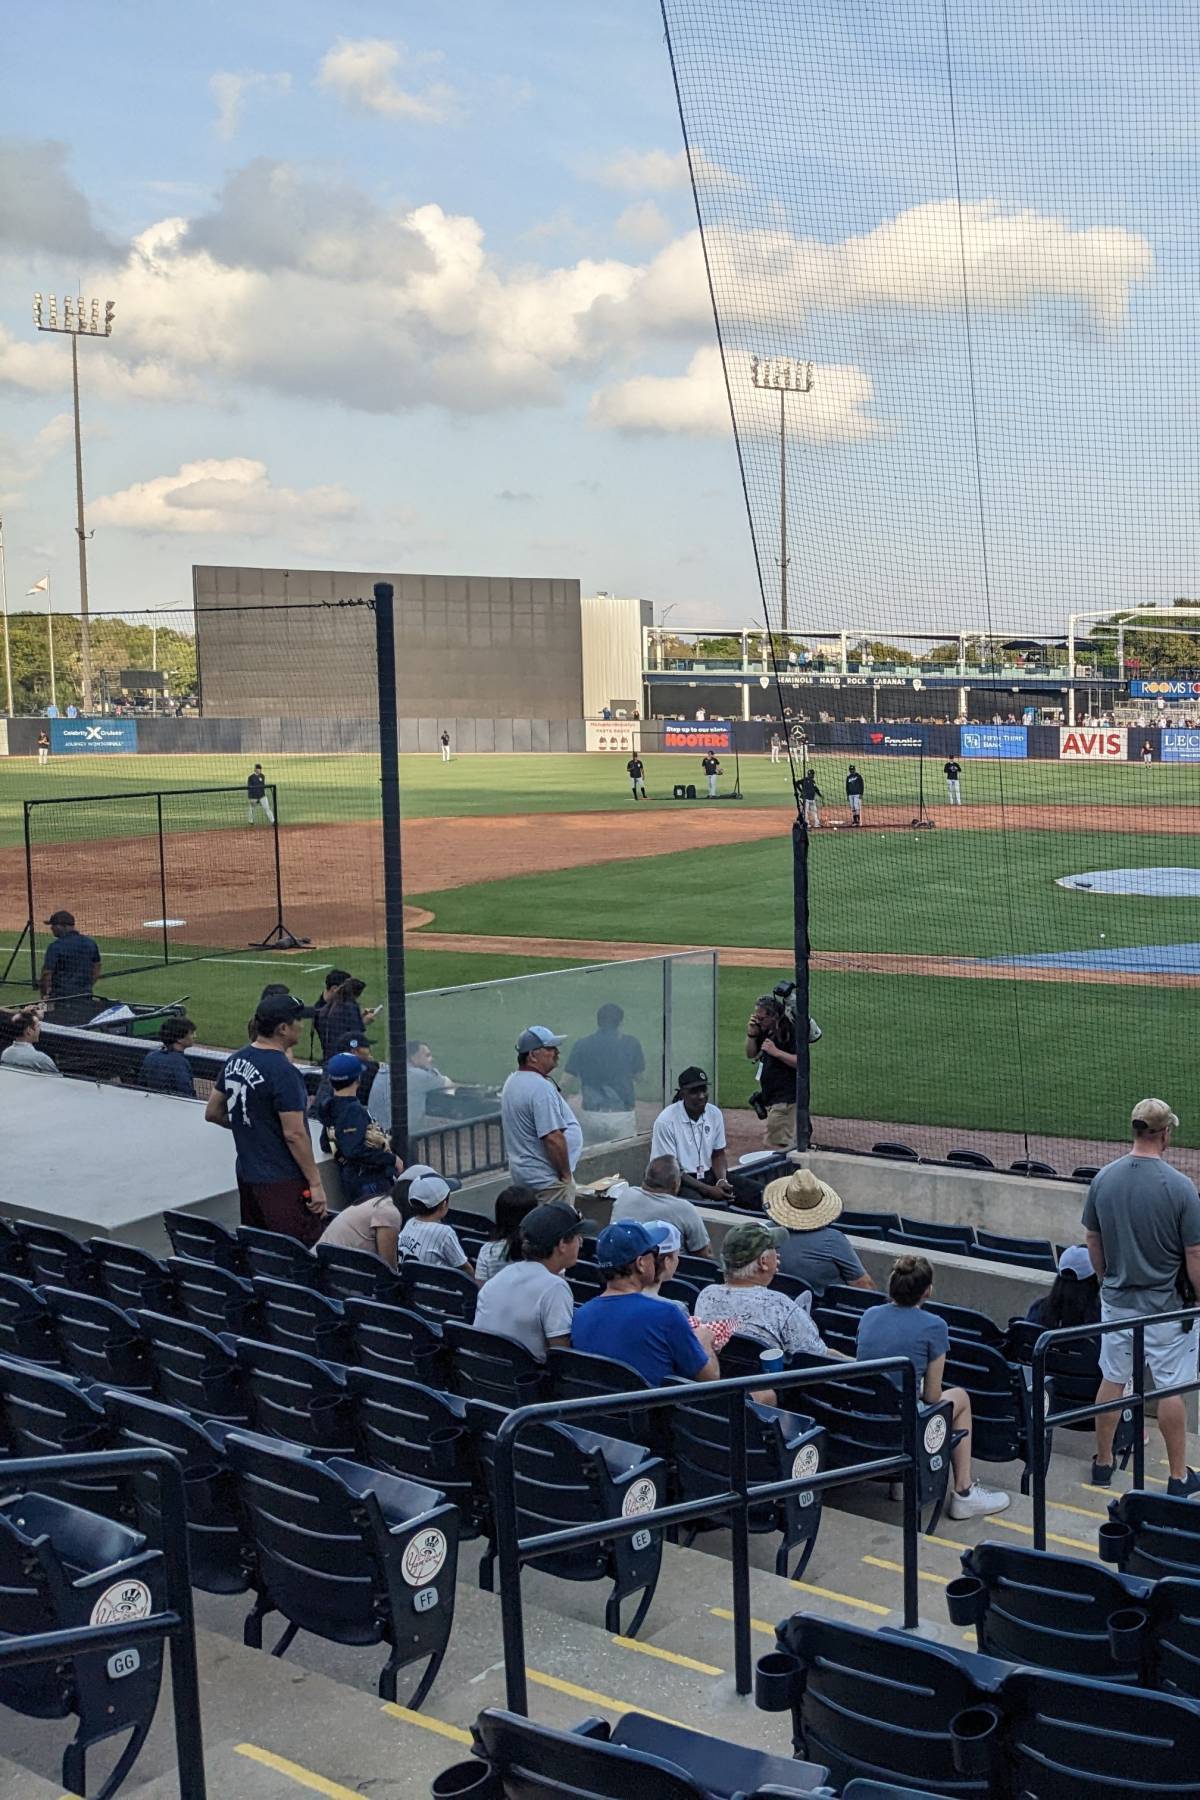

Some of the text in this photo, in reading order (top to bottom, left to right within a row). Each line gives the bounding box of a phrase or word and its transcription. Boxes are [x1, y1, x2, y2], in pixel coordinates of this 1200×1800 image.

[819, 677, 840, 685] HARD
[847, 677, 867, 685] ROCK
[873, 678, 906, 686] CABANAS
[1141, 682, 1185, 694] ROOMS
[665, 733, 729, 747] HOOTERS
[884, 736, 922, 747] Fanatics
[1062, 733, 1121, 755] AVIS
[224, 1079, 252, 1128] 71
[636, 1532, 648, 1547] EE
[420, 1592, 433, 1608] FF
[114, 1654, 135, 1673] GG
